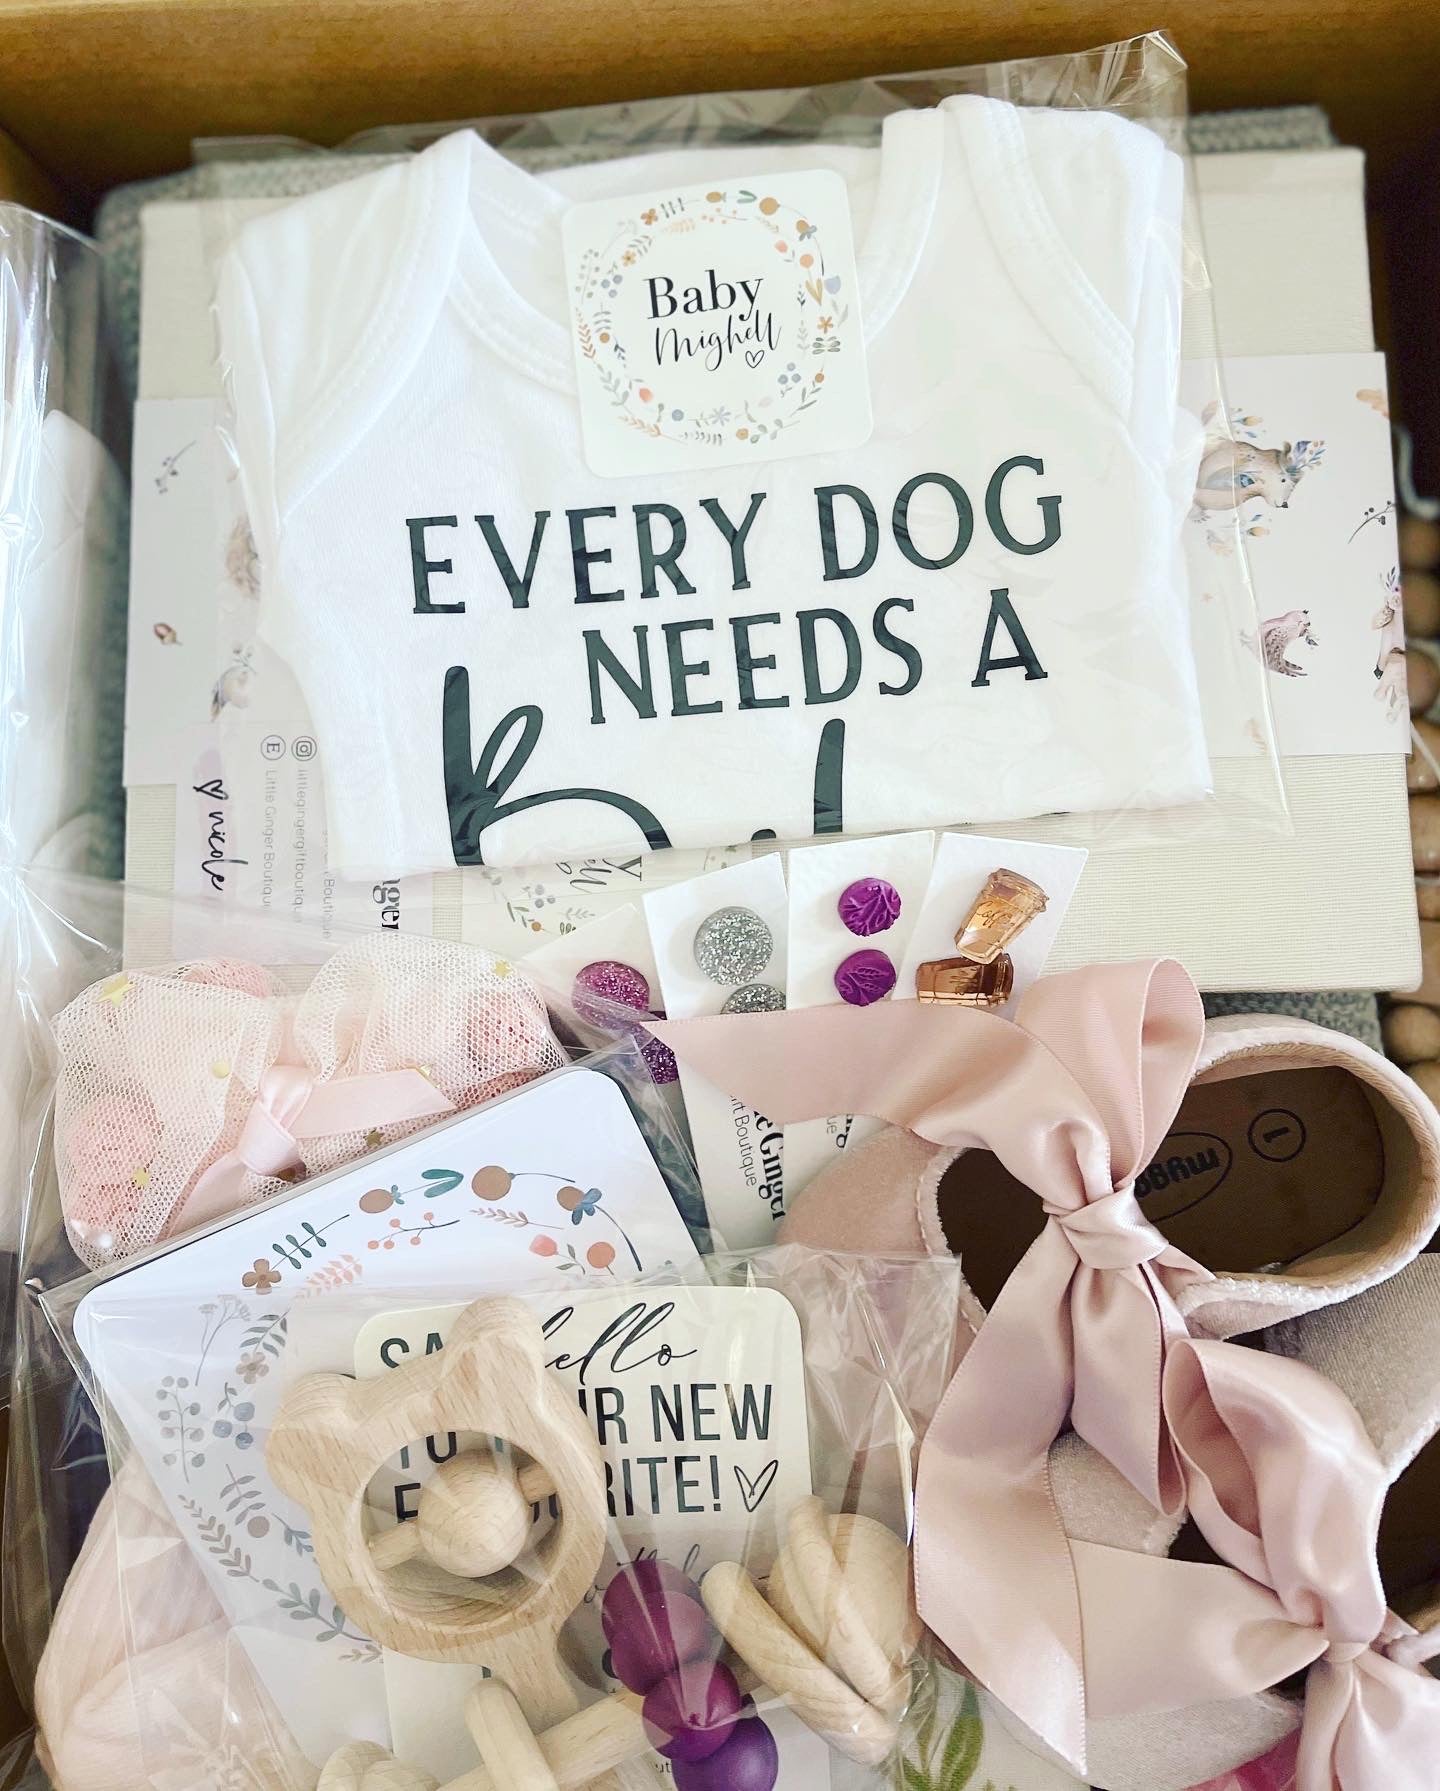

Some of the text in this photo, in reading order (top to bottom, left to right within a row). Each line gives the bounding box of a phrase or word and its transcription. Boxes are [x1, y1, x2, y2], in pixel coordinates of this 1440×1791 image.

[643, 269, 764, 322] Baby
[406, 455, 1062, 614] EVERY DOG
[582, 588, 1048, 724] NEEDS A
[201, 810, 249, 891] nicole
[261, 806, 277, 849] Ginger
[734, 1114, 758, 1188] Boutique
[650, 1383, 772, 1443] NEW
